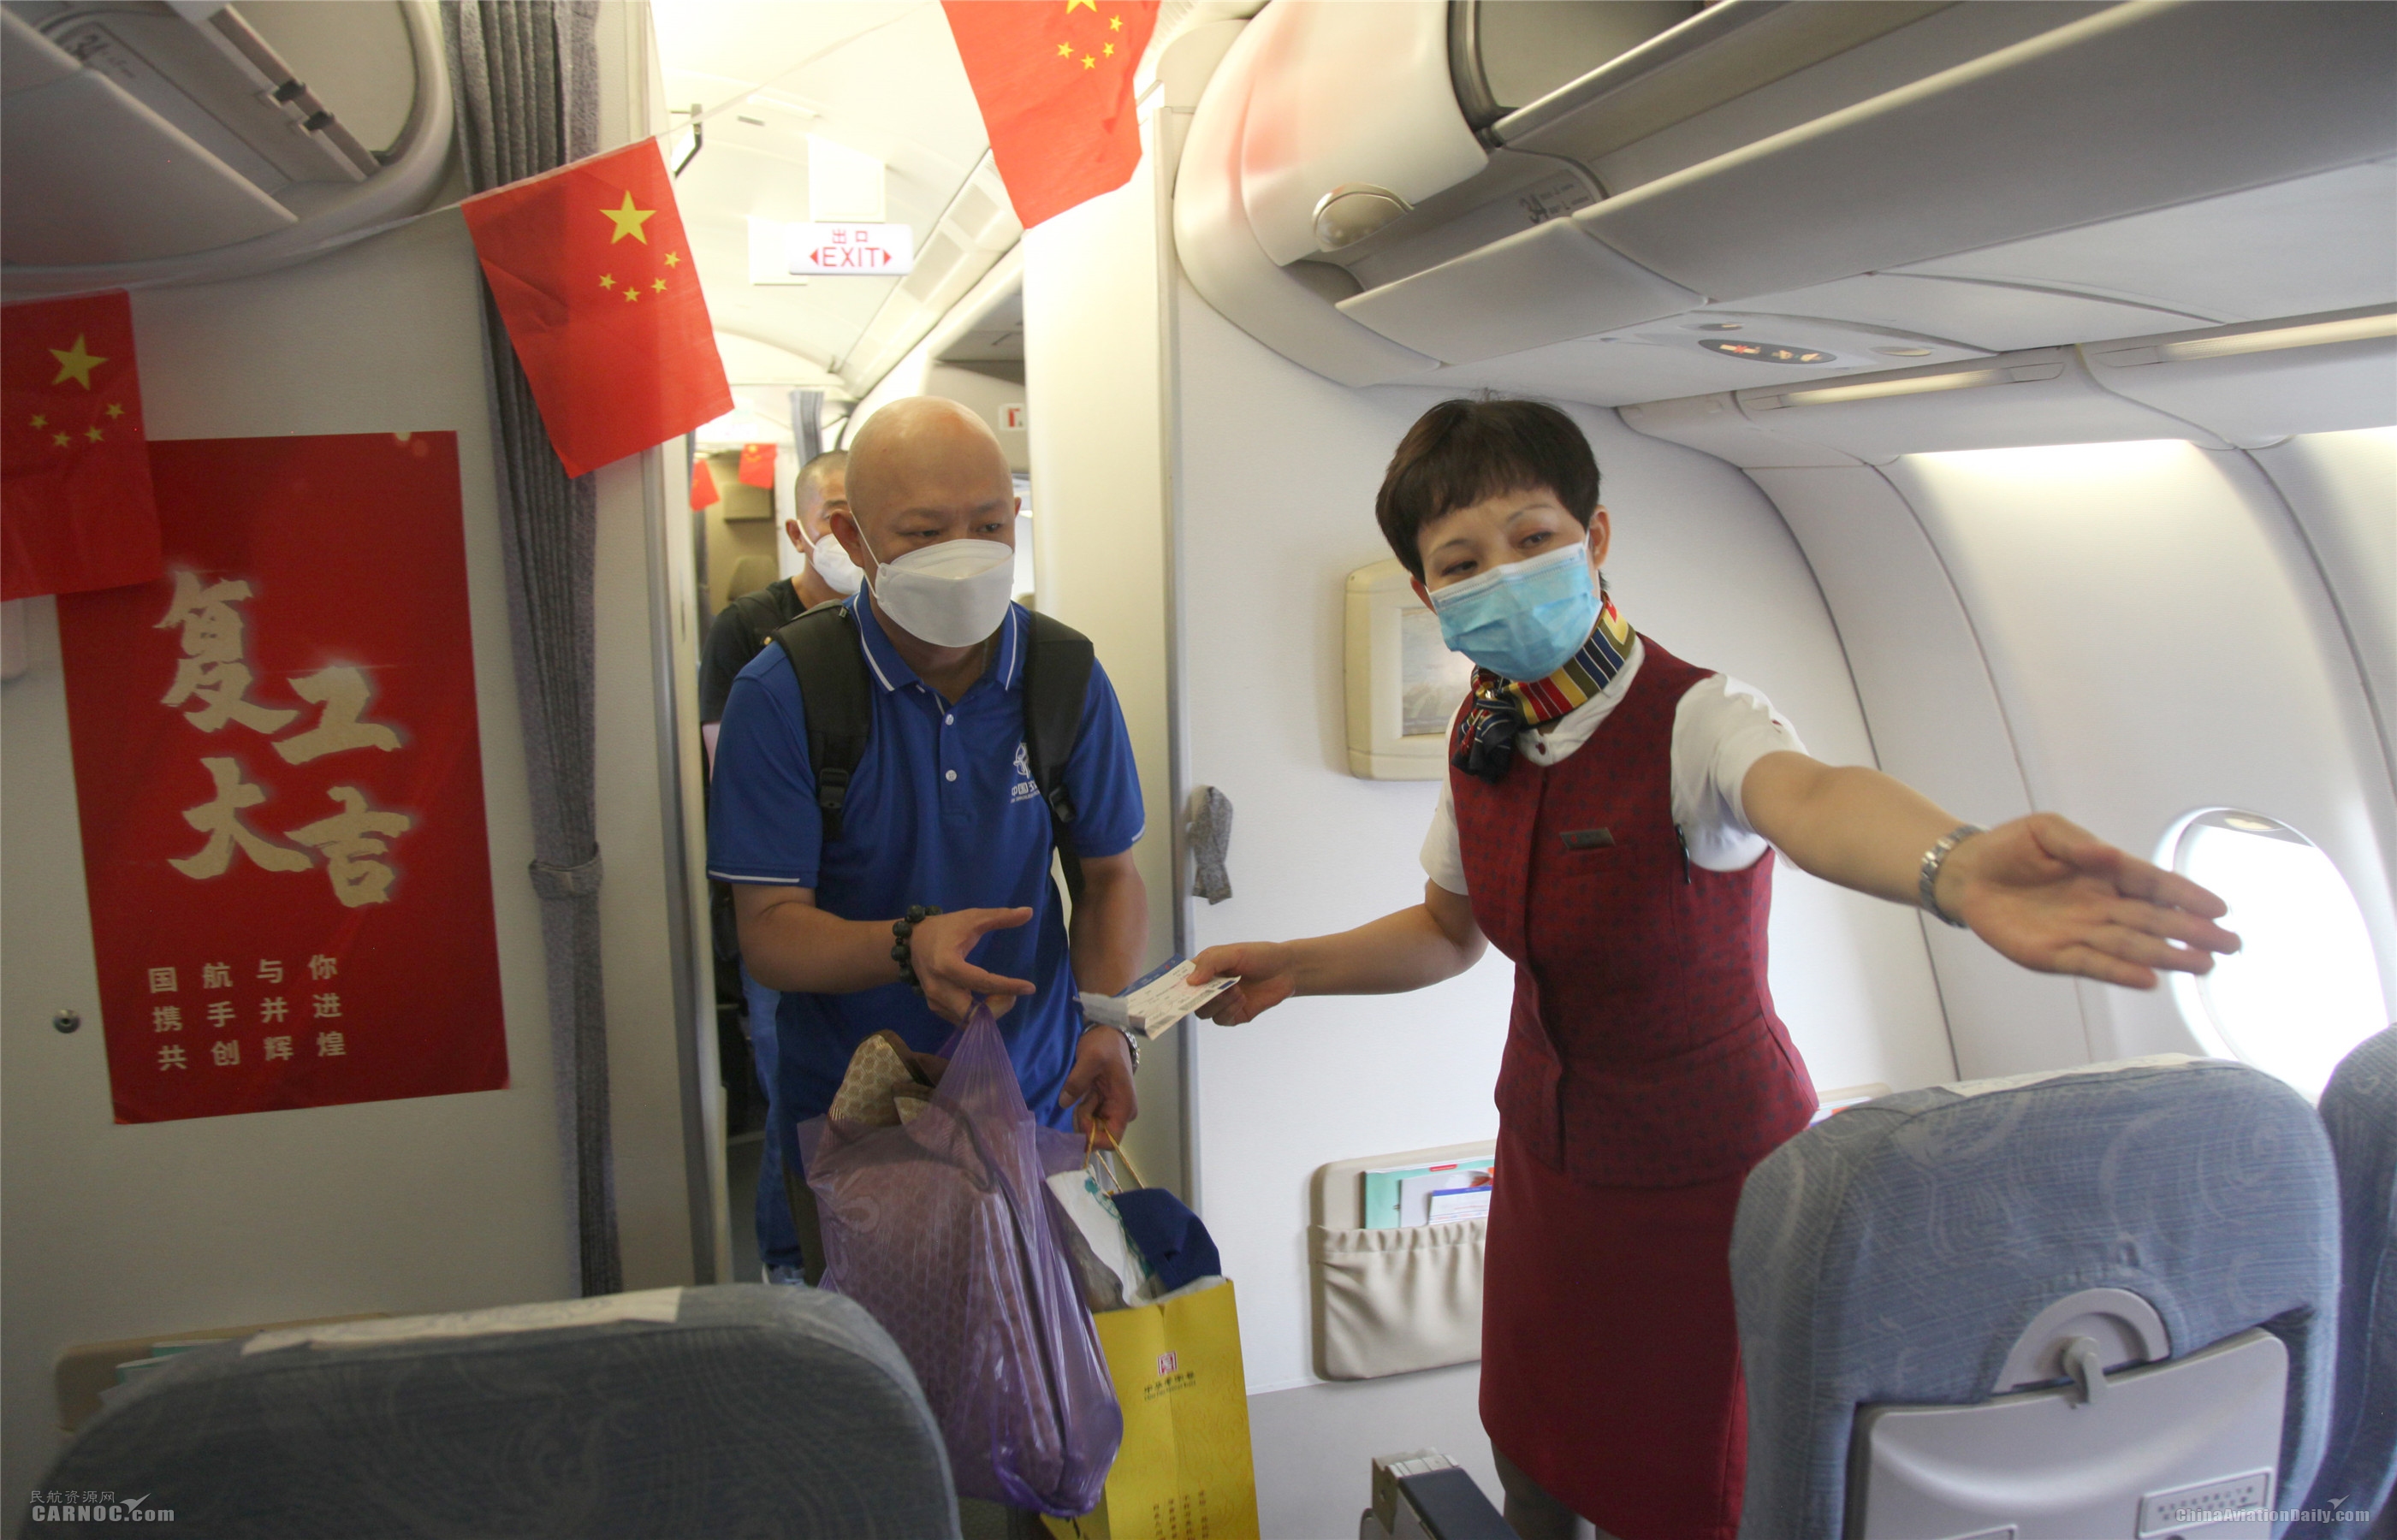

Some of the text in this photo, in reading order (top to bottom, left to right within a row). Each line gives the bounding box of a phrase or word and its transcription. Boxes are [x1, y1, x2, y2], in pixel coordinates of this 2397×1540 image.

[832, 228, 869, 244] 出口
[822, 246, 881, 267] EXIT
[152, 571, 401, 765] 复工
[167, 757, 410, 908] 大吉
[147, 954, 339, 994] 国航与你
[152, 992, 342, 1033] 携手并进
[157, 1031, 346, 1071] 共创辉煌
